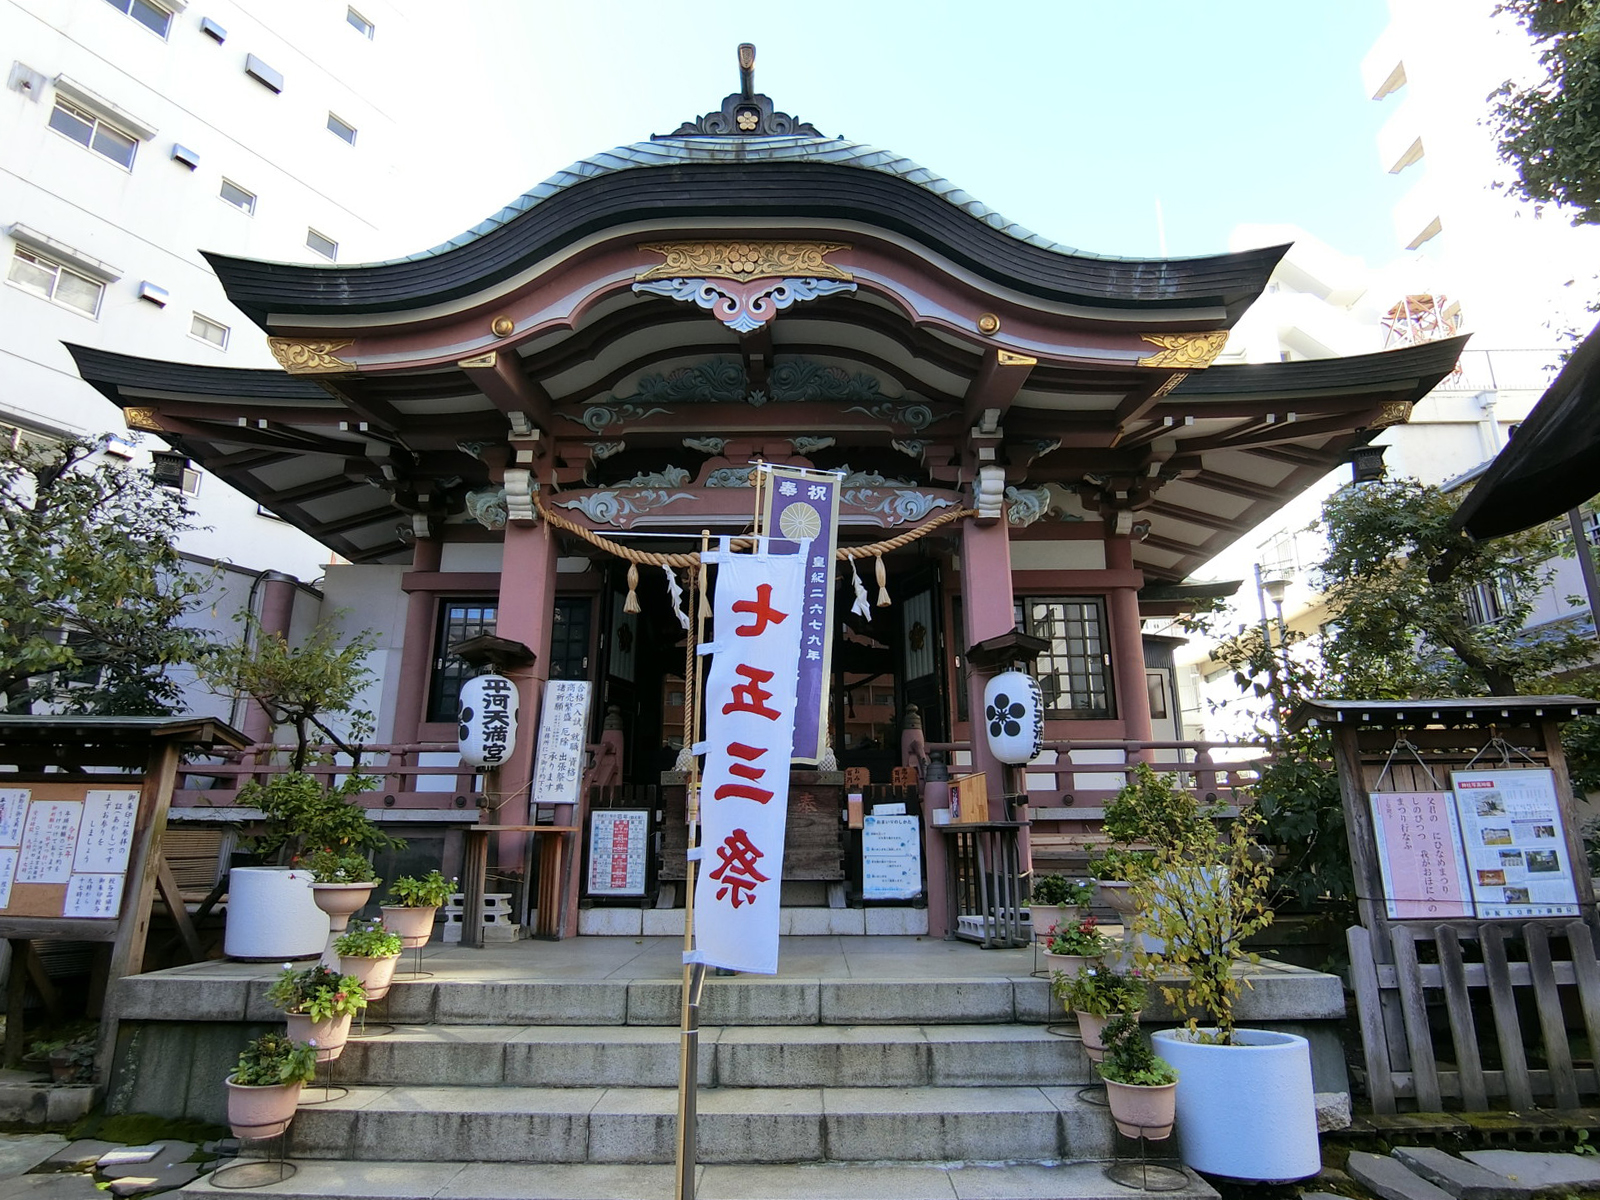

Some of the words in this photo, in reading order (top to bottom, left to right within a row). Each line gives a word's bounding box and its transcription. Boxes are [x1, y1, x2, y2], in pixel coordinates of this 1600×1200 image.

[778, 481, 827, 501] 奉祝
[806, 556, 826, 661] 皇紀二六七九年
[554, 683, 566, 711] 諸祈願
[563, 683, 576, 722] 商売繁盛
[481, 679, 511, 762] 平河天満宮
[559, 727, 571, 747] 厄除
[545, 751, 558, 792] 承ります
[554, 752, 567, 793] 出張祭典
[97, 794, 112, 846] まずお参りを
[119, 794, 136, 854] 御朱印は参拝の
[1396, 797, 1413, 850] まつり行なふ
[1412, 797, 1427, 840] しのびつつ
[84, 820, 95, 863] しましょう
[1426, 797, 1438, 822] 父君の
[1433, 832, 1449, 894] にひなめまつり
